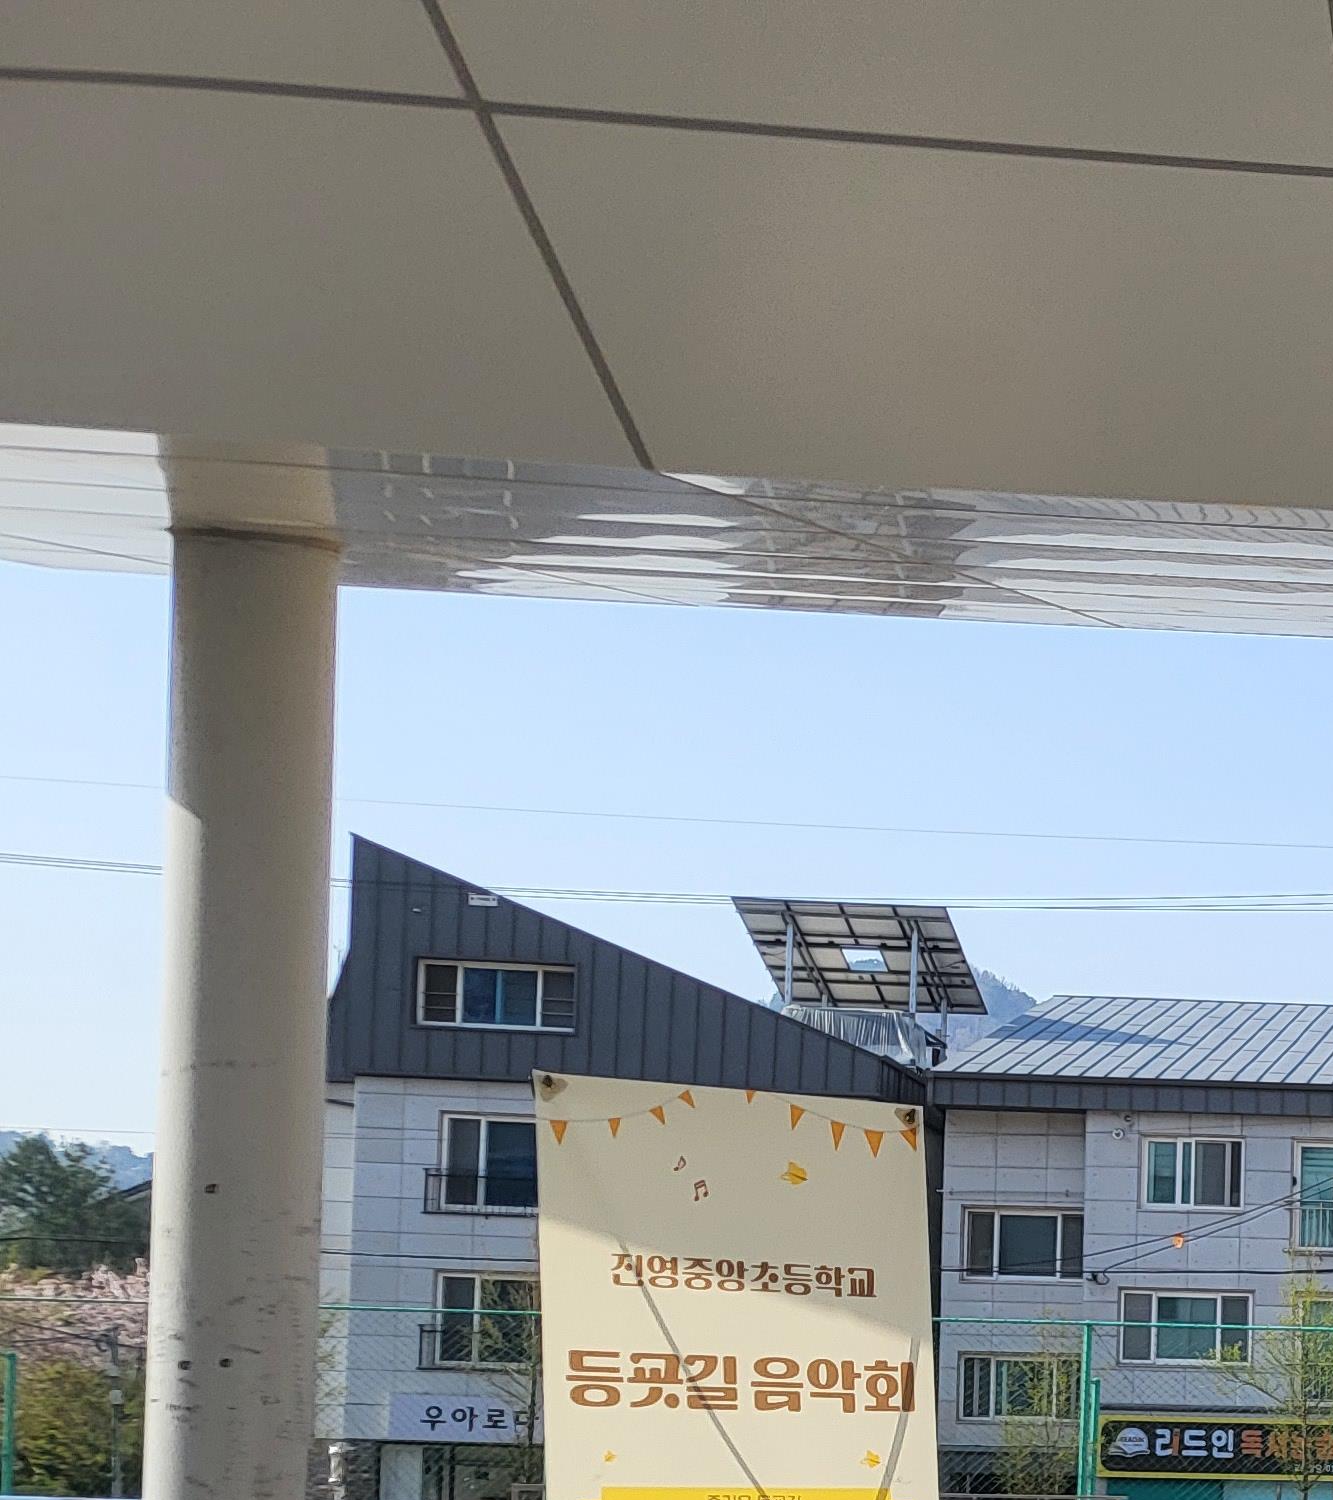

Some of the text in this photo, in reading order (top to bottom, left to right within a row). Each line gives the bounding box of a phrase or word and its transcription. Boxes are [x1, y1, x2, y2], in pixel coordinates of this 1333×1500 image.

[611, 1253, 877, 1298] 진영중앙초등학교
[565, 1350, 915, 1413] 등굣길 음악회
